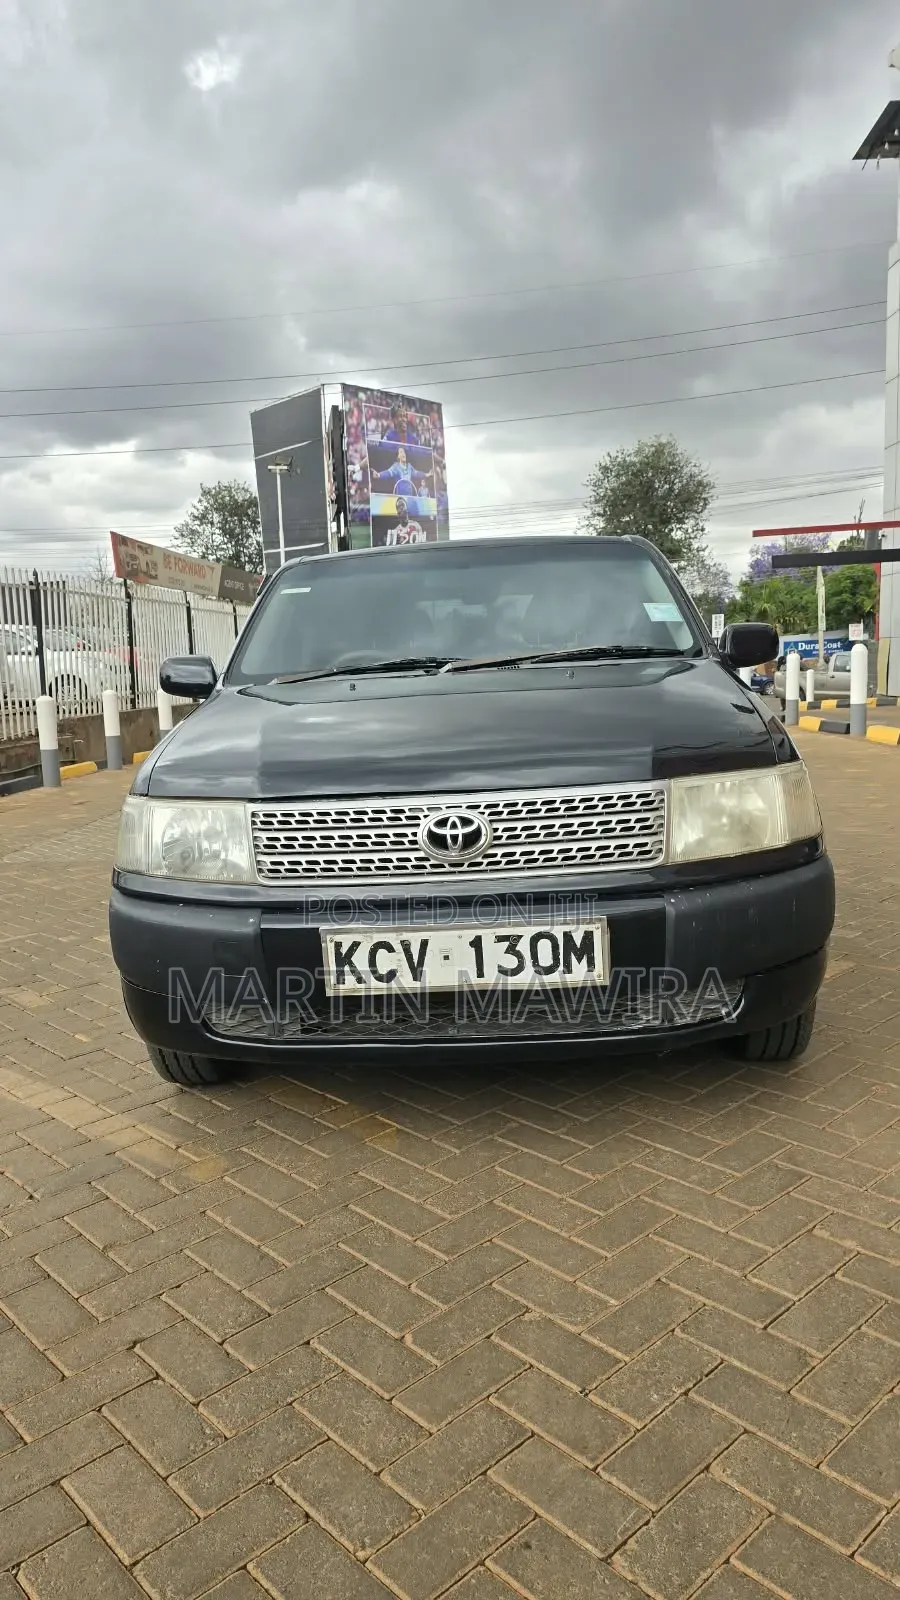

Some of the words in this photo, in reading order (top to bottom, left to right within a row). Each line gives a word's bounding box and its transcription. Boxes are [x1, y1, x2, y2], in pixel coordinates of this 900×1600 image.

[173, 555, 206, 579] FORWARD
[333, 938, 430, 985] KCV
[468, 930, 596, 979] 130M
